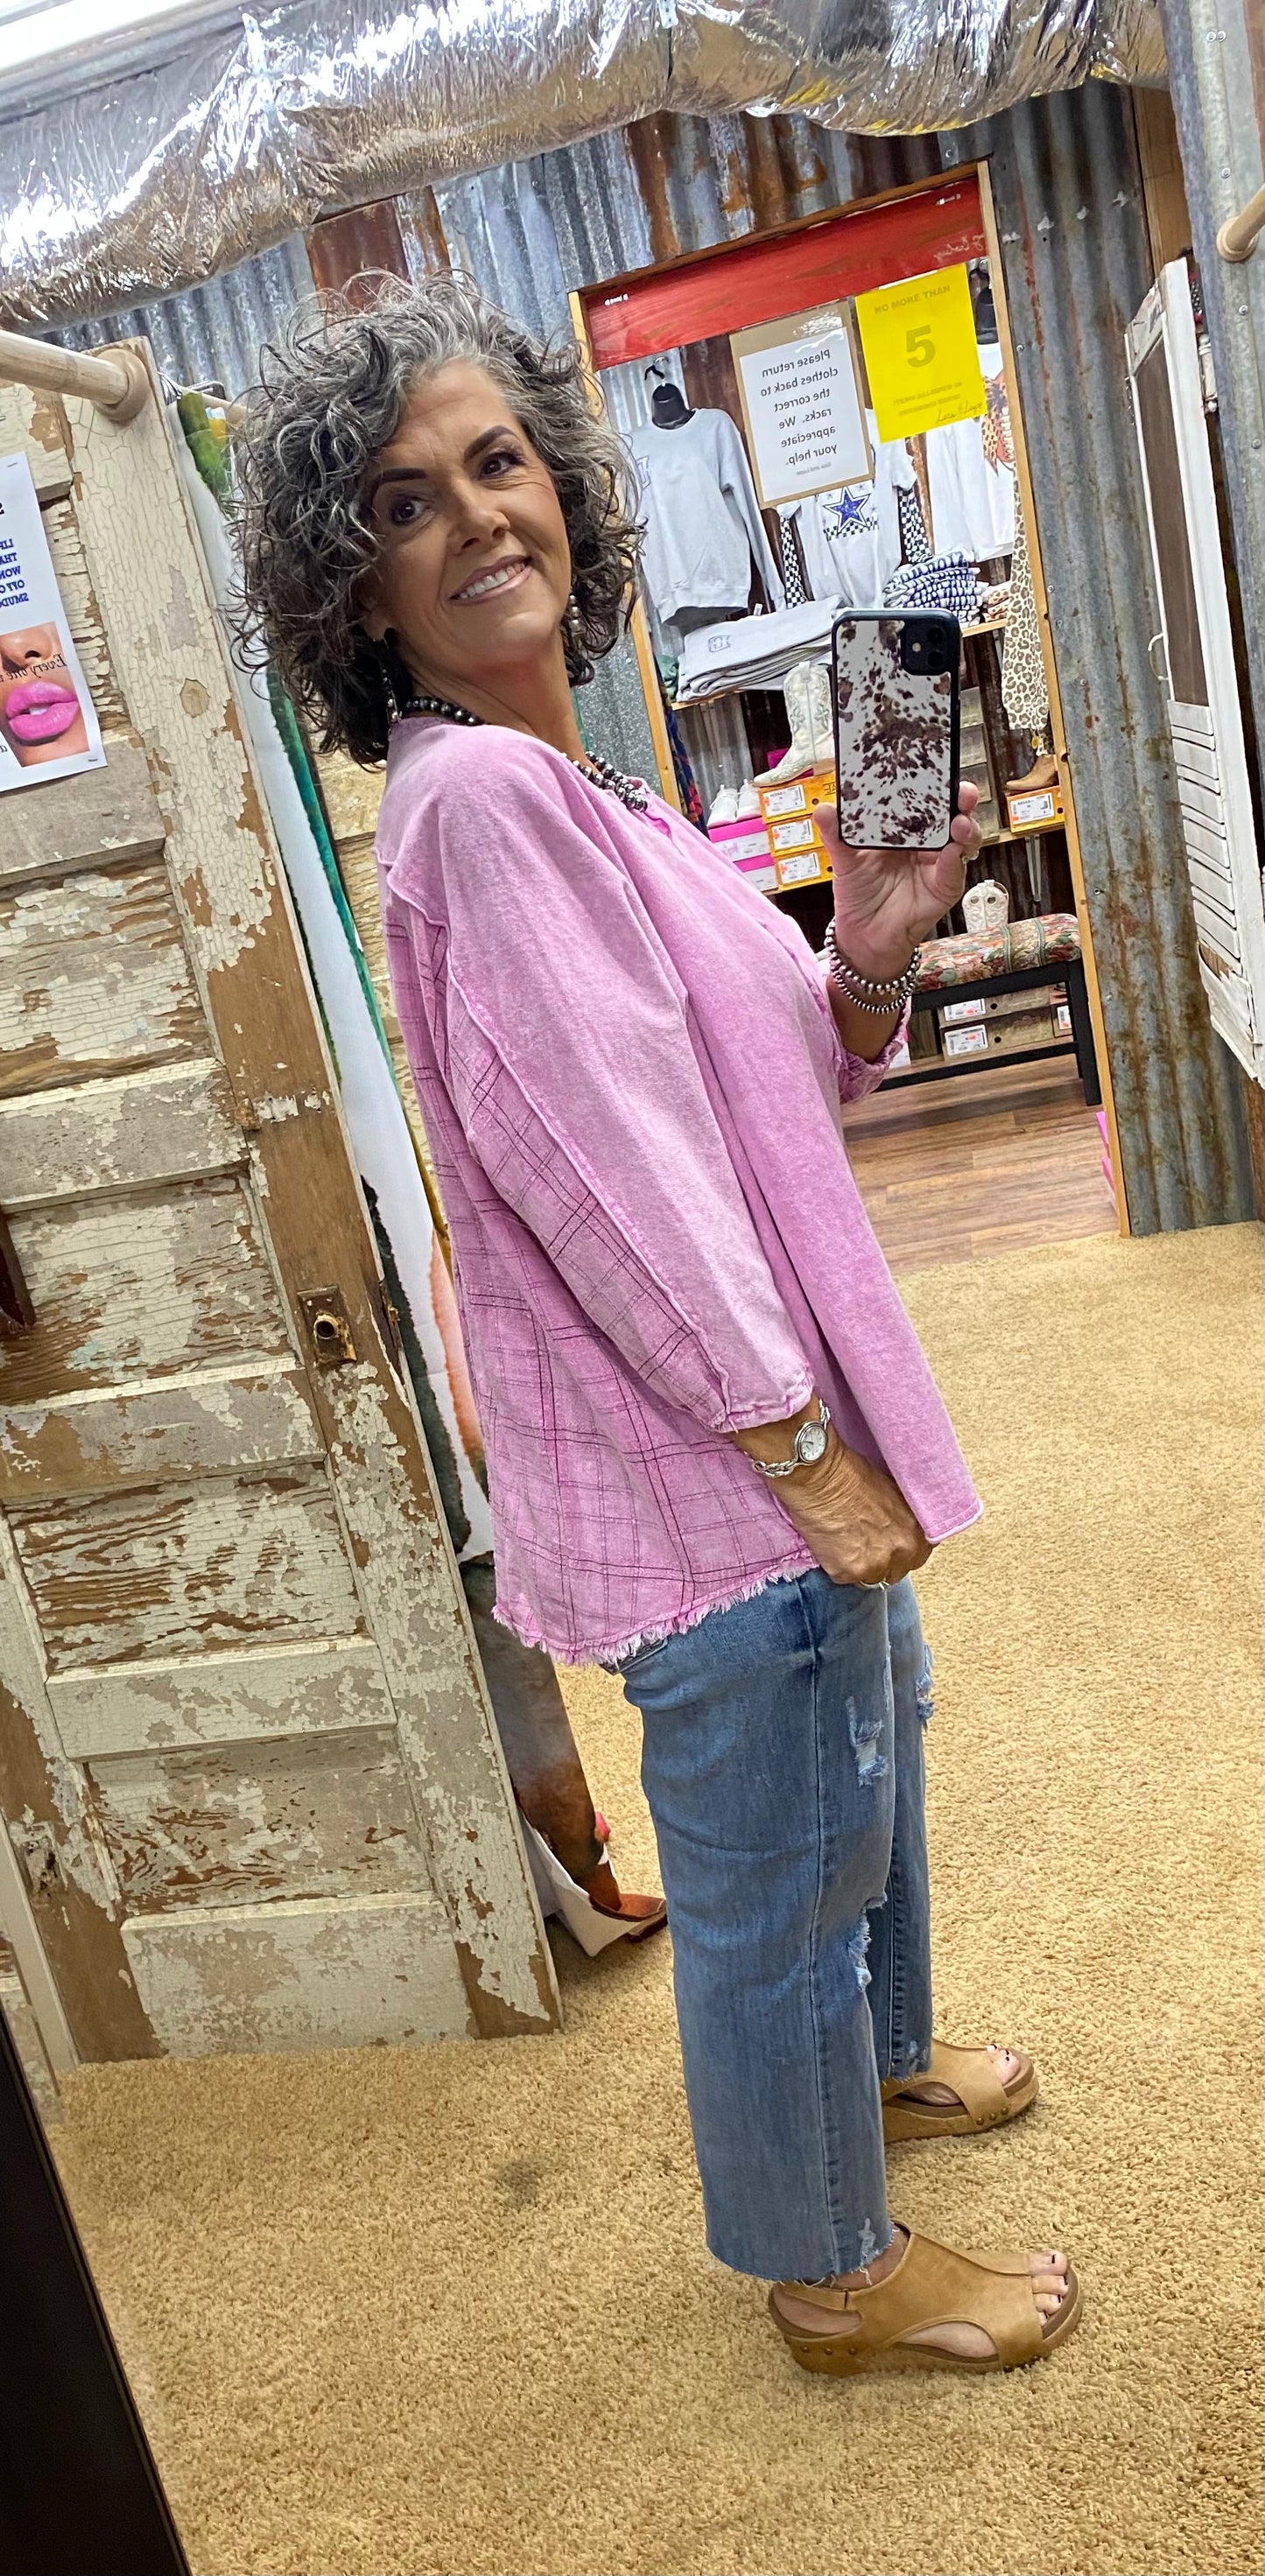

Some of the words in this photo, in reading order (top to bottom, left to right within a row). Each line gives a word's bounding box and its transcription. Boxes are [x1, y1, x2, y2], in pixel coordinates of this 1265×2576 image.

[875, 304, 889, 314] NO
[891, 293, 920, 310] MORE
[923, 284, 951, 298] THAN
[905, 324, 936, 368] 5
